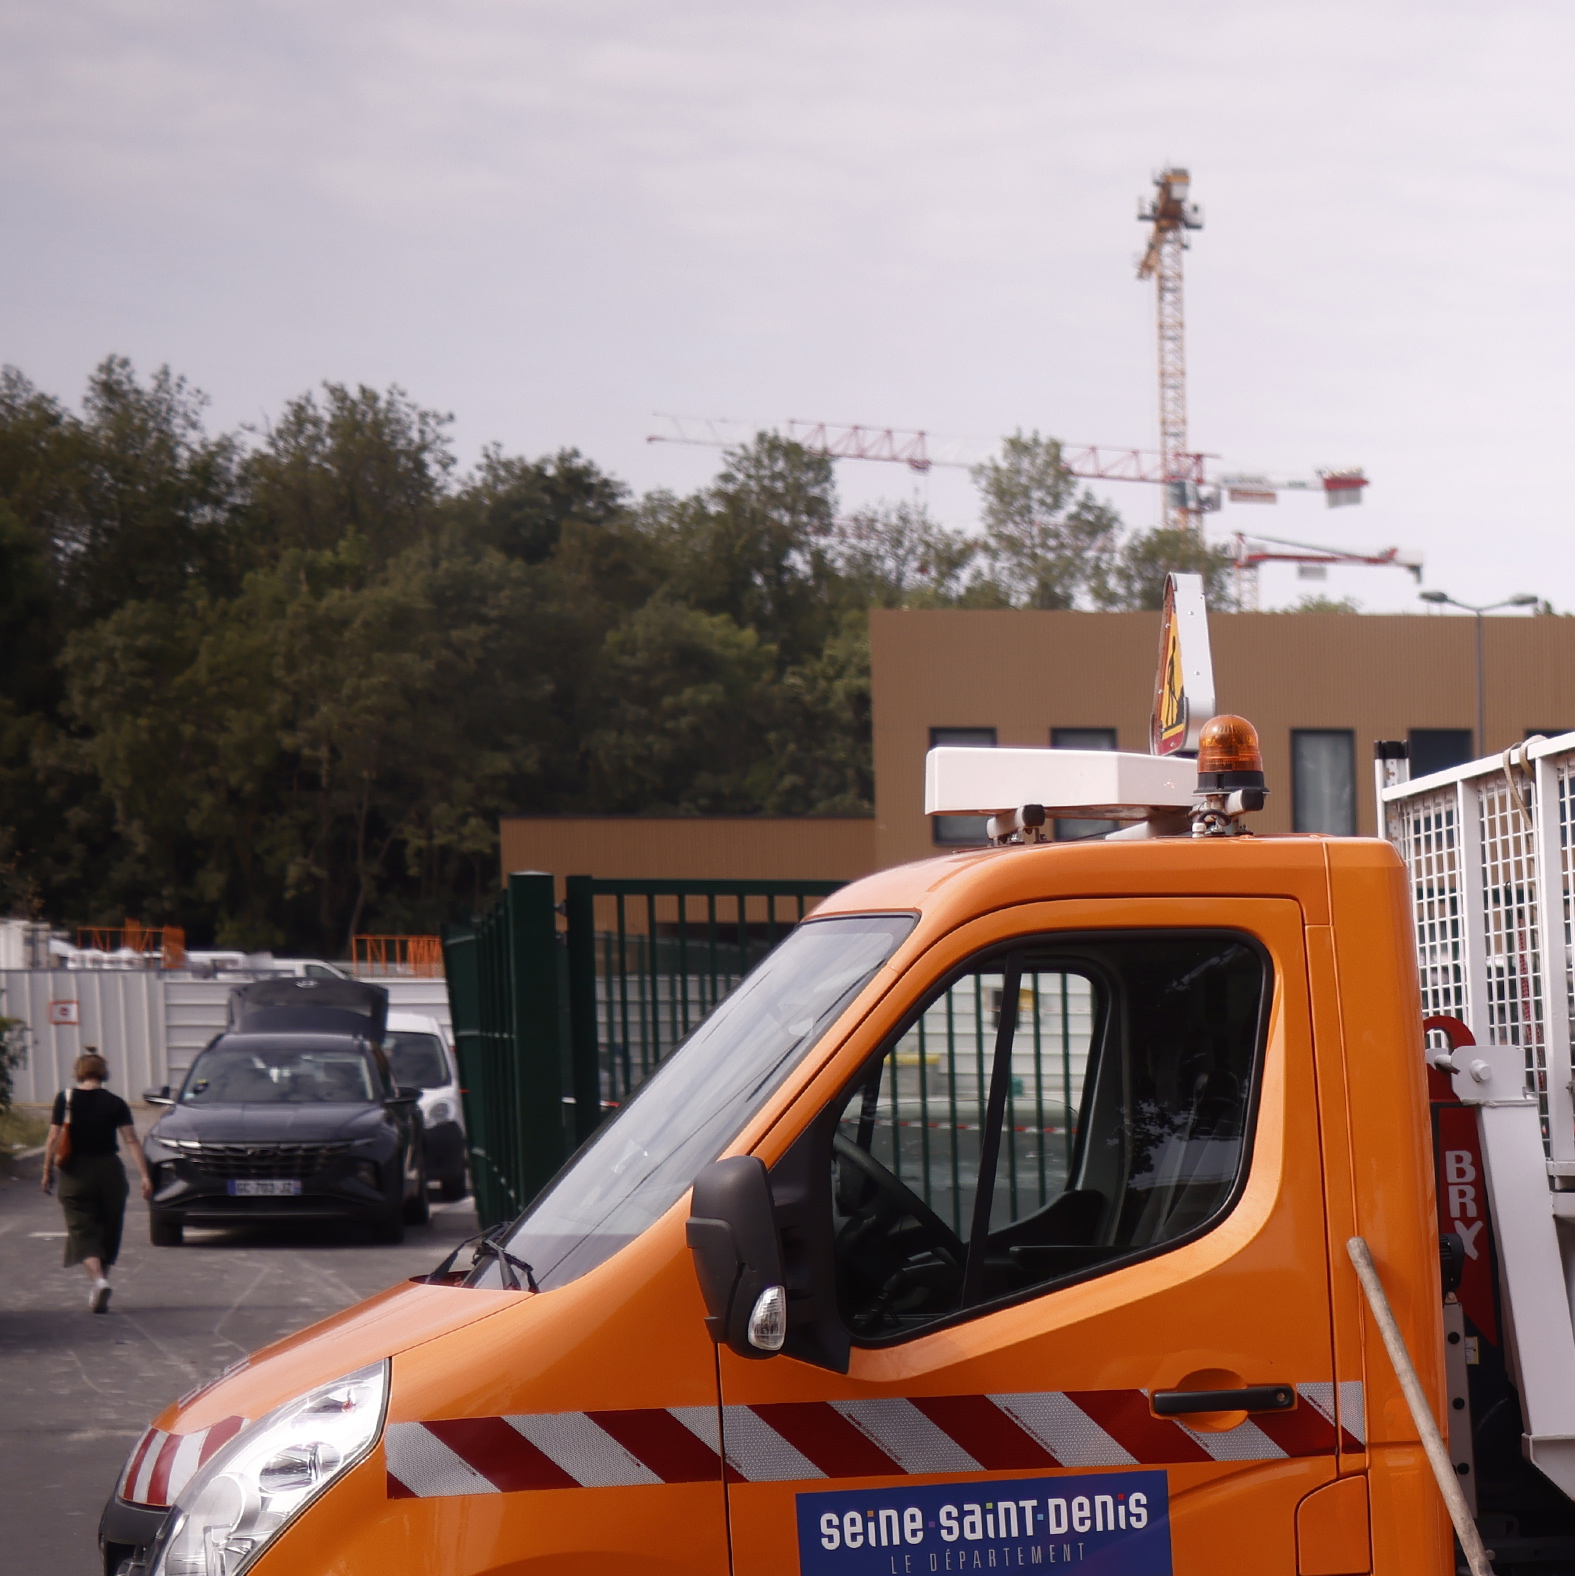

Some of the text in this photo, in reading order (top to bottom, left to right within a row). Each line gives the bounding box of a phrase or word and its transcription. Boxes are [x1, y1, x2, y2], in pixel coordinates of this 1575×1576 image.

[1445, 1150, 1483, 1260] BRY
[890, 1541, 1086, 1575] LE DÉPARTEMENT
